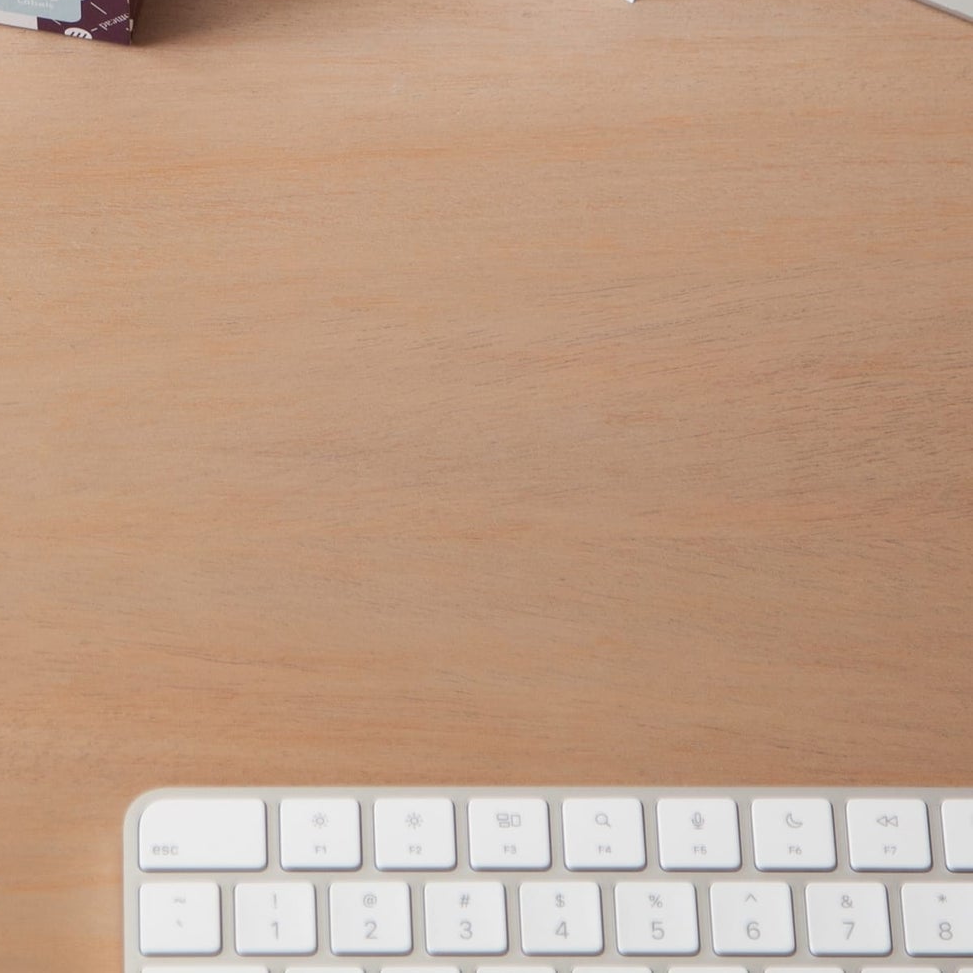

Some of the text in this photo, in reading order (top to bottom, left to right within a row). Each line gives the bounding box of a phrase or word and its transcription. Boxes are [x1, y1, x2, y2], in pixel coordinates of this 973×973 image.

[152, 845, 179, 856] esc
[315, 845, 327, 855] F1
[408, 845, 422, 855] F2
[503, 845, 517, 855] F3
[598, 845, 612, 855] F4
[693, 845, 707, 855] F5
[788, 845, 802, 855] F6
[884, 845, 897, 855] F7
[363, 894, 377, 908] @
[459, 894, 470, 907] #
[555, 893, 565, 909] $
[648, 894, 663, 908] %
[841, 894, 853, 909] &
[271, 921, 279, 939] 1
[364, 921, 378, 939] 2
[459, 921, 473, 940] 3
[555, 921, 569, 940] 4
[651, 921, 665, 940] 5
[746, 921, 761, 940] 6
[843, 922, 856, 940] 7
[938, 921, 953, 941] 8
